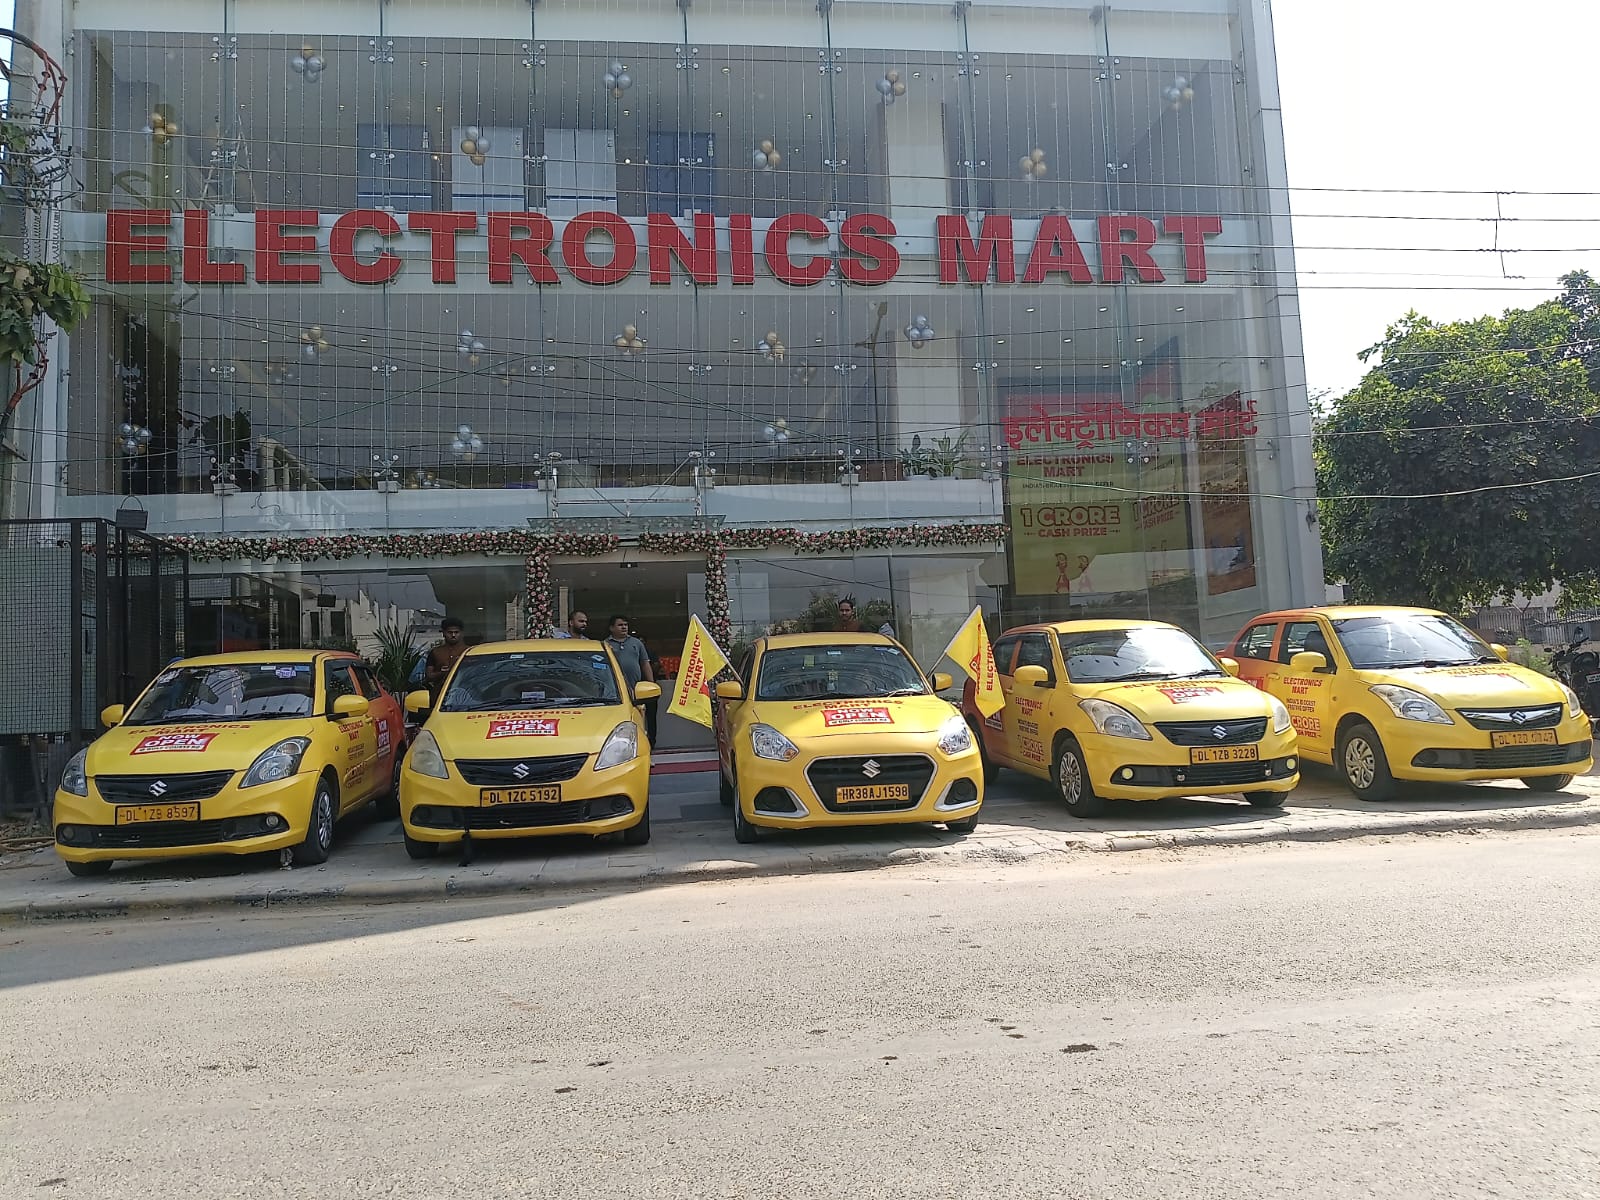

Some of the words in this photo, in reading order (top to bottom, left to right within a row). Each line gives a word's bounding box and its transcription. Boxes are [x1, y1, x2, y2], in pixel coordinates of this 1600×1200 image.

[105, 208, 901, 285] ELECTRONICS
[935, 214, 1223, 285] MART
[1195, 400, 1258, 440] मार्ट
[1043, 466, 1085, 477] MART
[1020, 507, 1033, 527] 1
[1037, 506, 1120, 527] CRORE
[1038, 527, 1071, 538] CASH
[1073, 526, 1107, 537] PRIZE
[691, 658, 704, 689] MART
[1283, 677, 1323, 687] ELECTRONICS
[1291, 686, 1309, 694] MART
[466, 710, 583, 720] ELECTRONICS
[496, 724, 551, 732] OPEN
[1291, 716, 1321, 731] CRORE
[144, 738, 204, 747] OPEN
[1197, 750, 1209, 761] DL
[1212, 749, 1229, 761] 1ZB
[1233, 748, 1256, 759] 3228
[489, 792, 503, 804] DL
[507, 790, 527, 802] 1ZC
[530, 788, 557, 801] 5192
[842, 785, 908, 801] HR38AJ1598
[126, 809, 138, 822] DL
[166, 806, 195, 819] 8597
